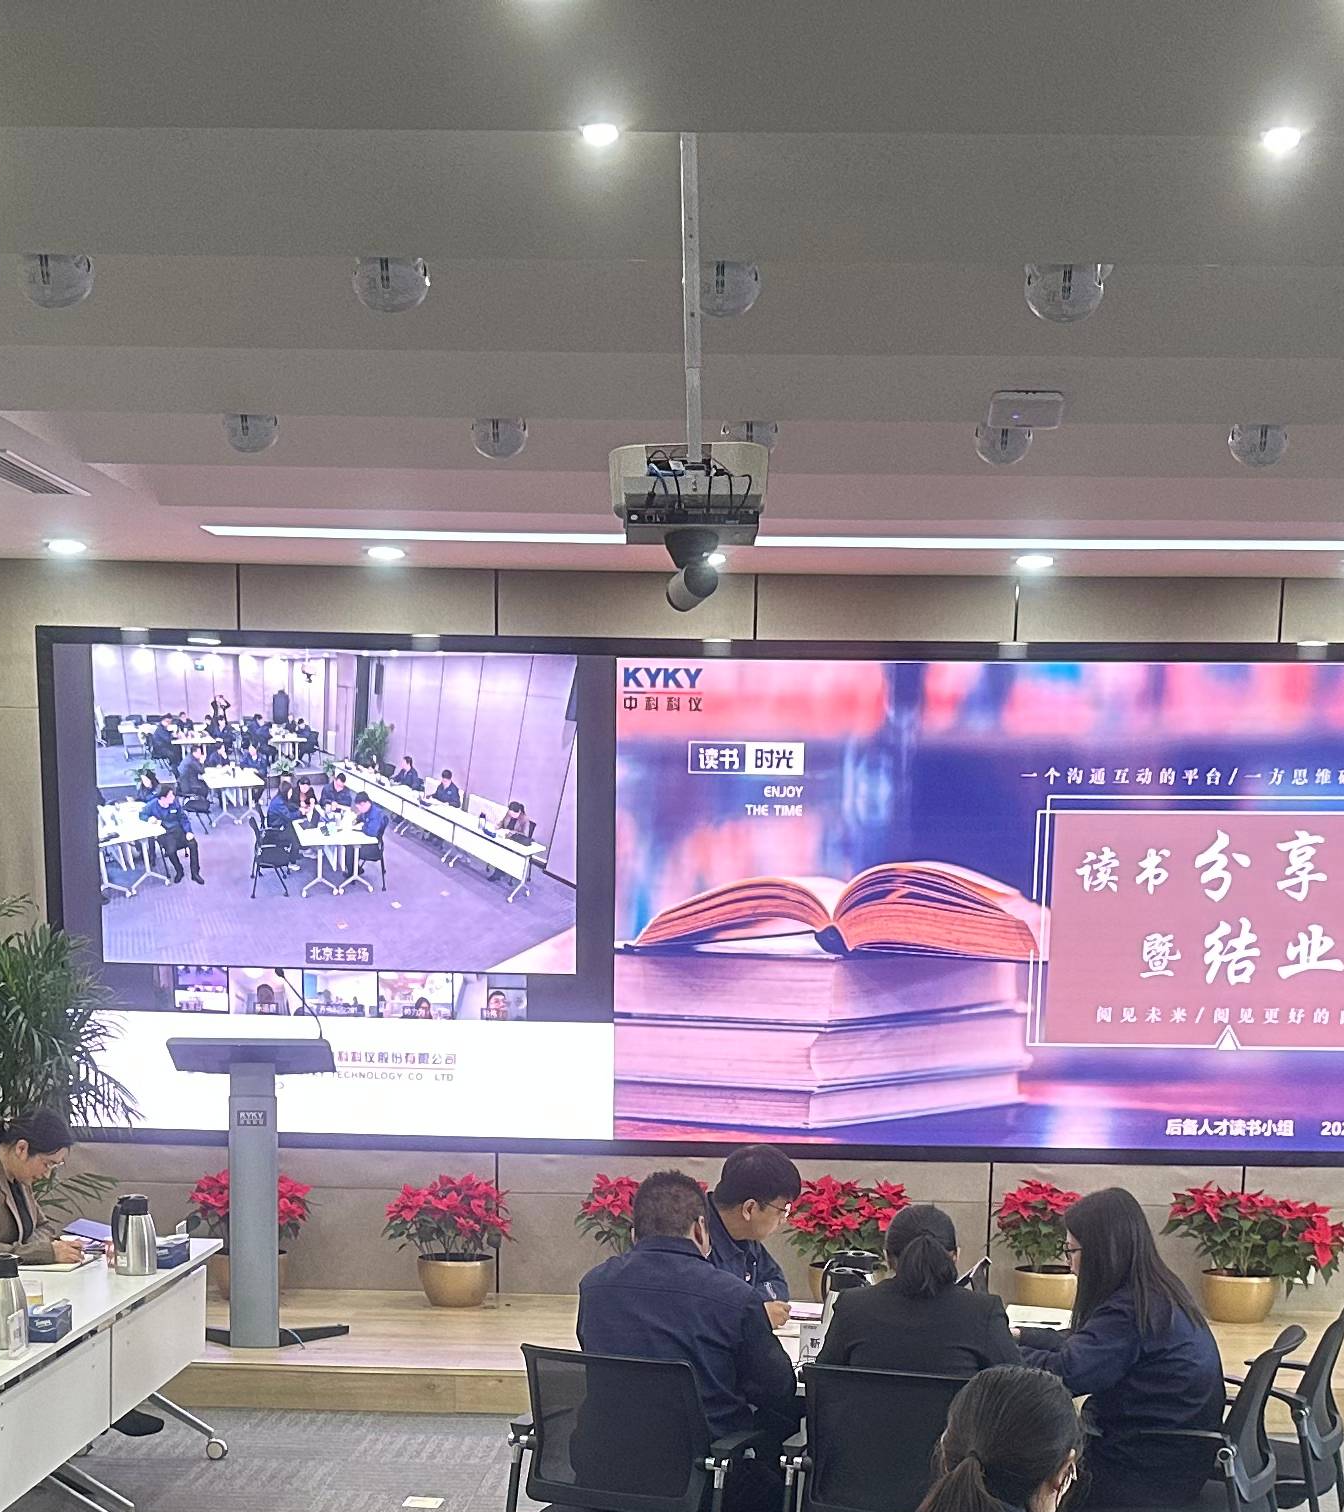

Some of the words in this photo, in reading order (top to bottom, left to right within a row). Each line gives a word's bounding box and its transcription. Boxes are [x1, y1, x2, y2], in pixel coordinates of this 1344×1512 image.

[623, 667, 703, 689] KYKY
[623, 695, 703, 712] 中科科仪
[698, 747, 739, 769] 读书
[754, 749, 794, 769] 时光
[763, 785, 803, 798] ENJOY
[745, 804, 769, 816] THE
[773, 804, 803, 816] TIME
[309, 946, 370, 962] 北京主会场
[1165, 1118, 1295, 1137] 后备人才读书小组
